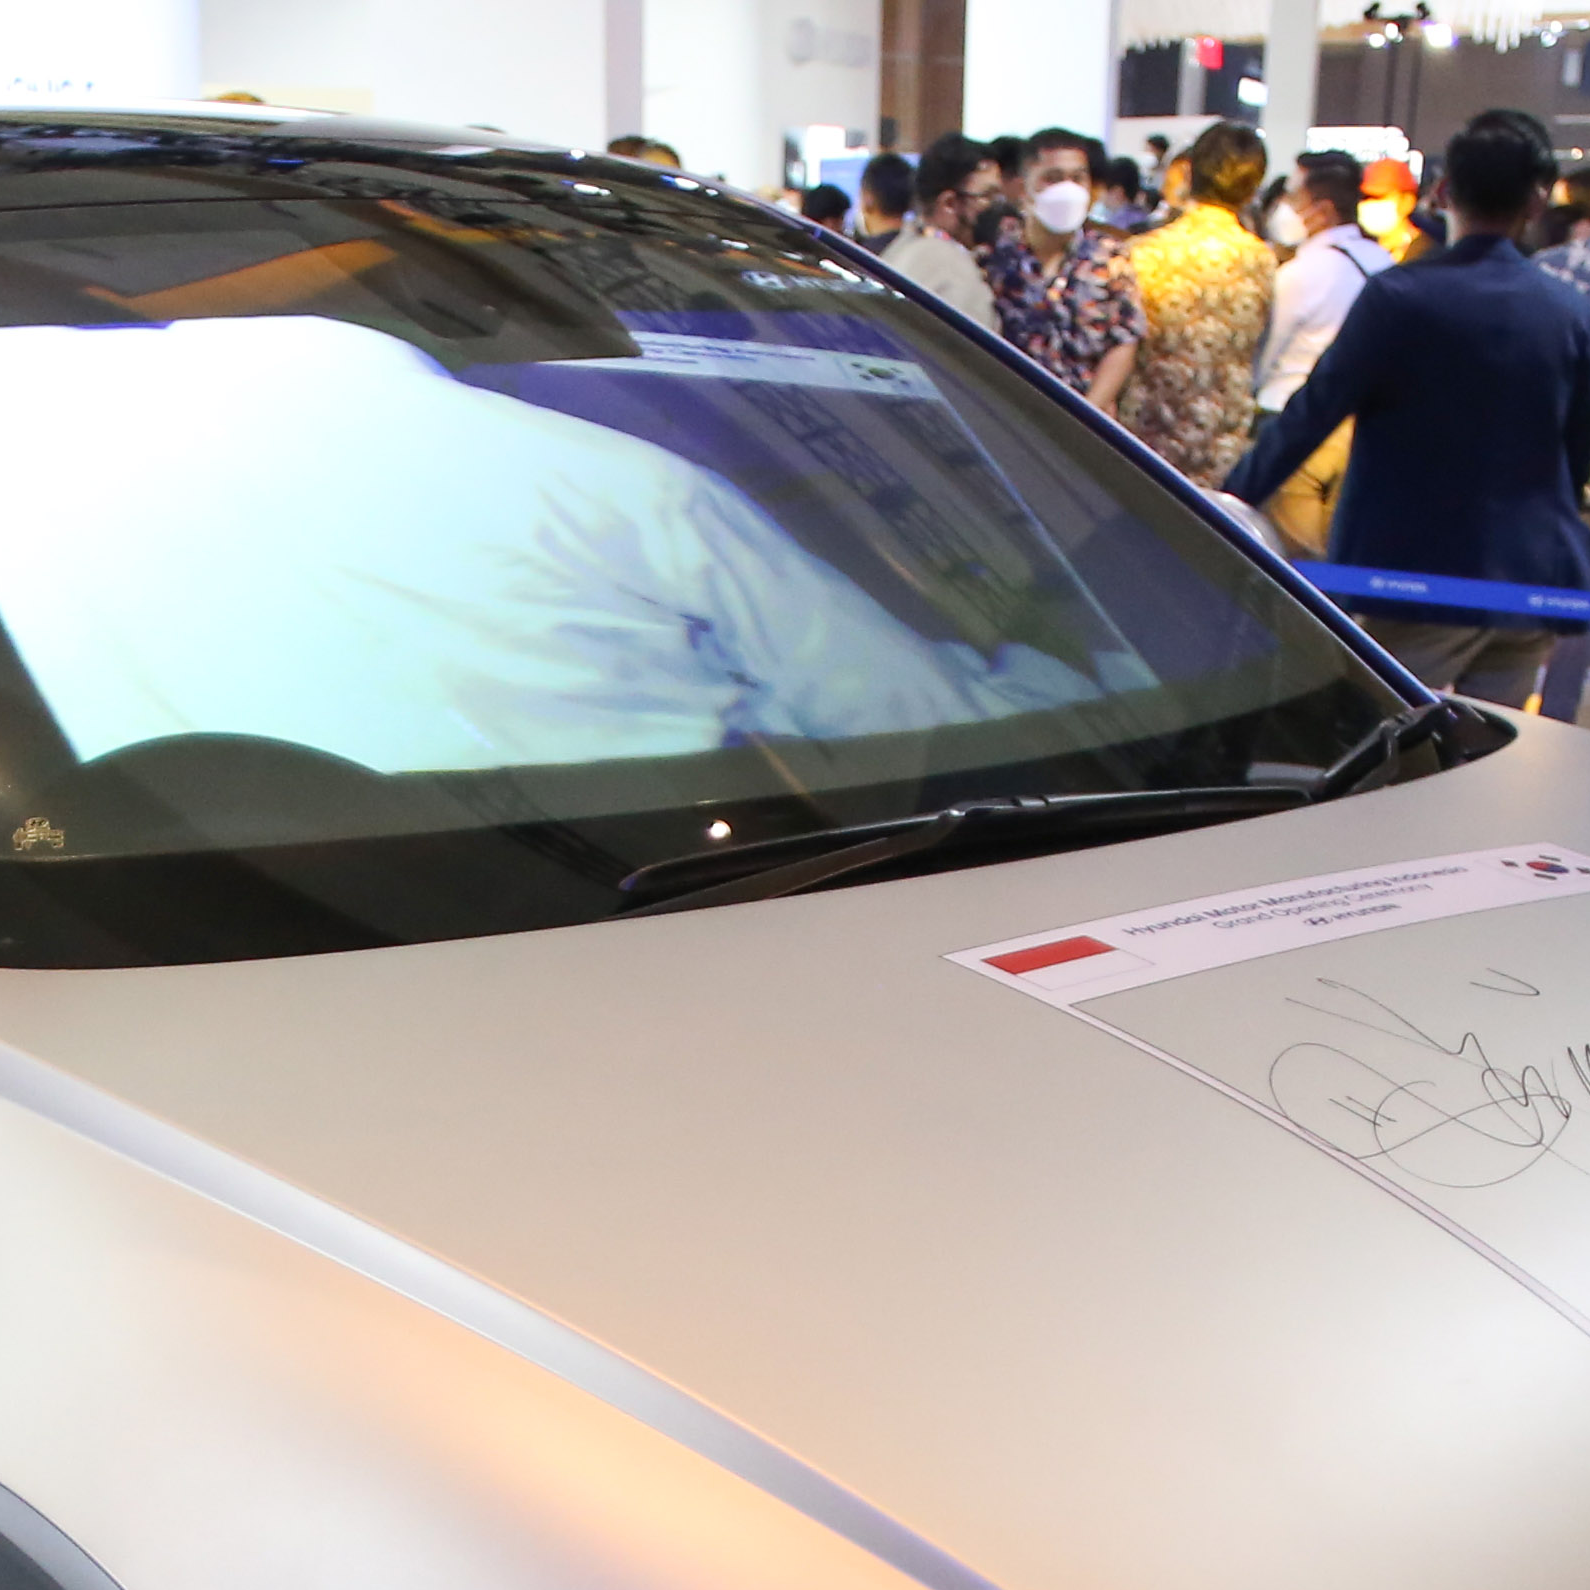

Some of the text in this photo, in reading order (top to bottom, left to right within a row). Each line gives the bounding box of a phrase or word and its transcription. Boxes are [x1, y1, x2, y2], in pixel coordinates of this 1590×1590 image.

[1122, 865, 1469, 937] Hyundai Motor Manufacturing Indonesia
[1212, 912, 1274, 930] Grand
[1270, 898, 1352, 917] Opening
